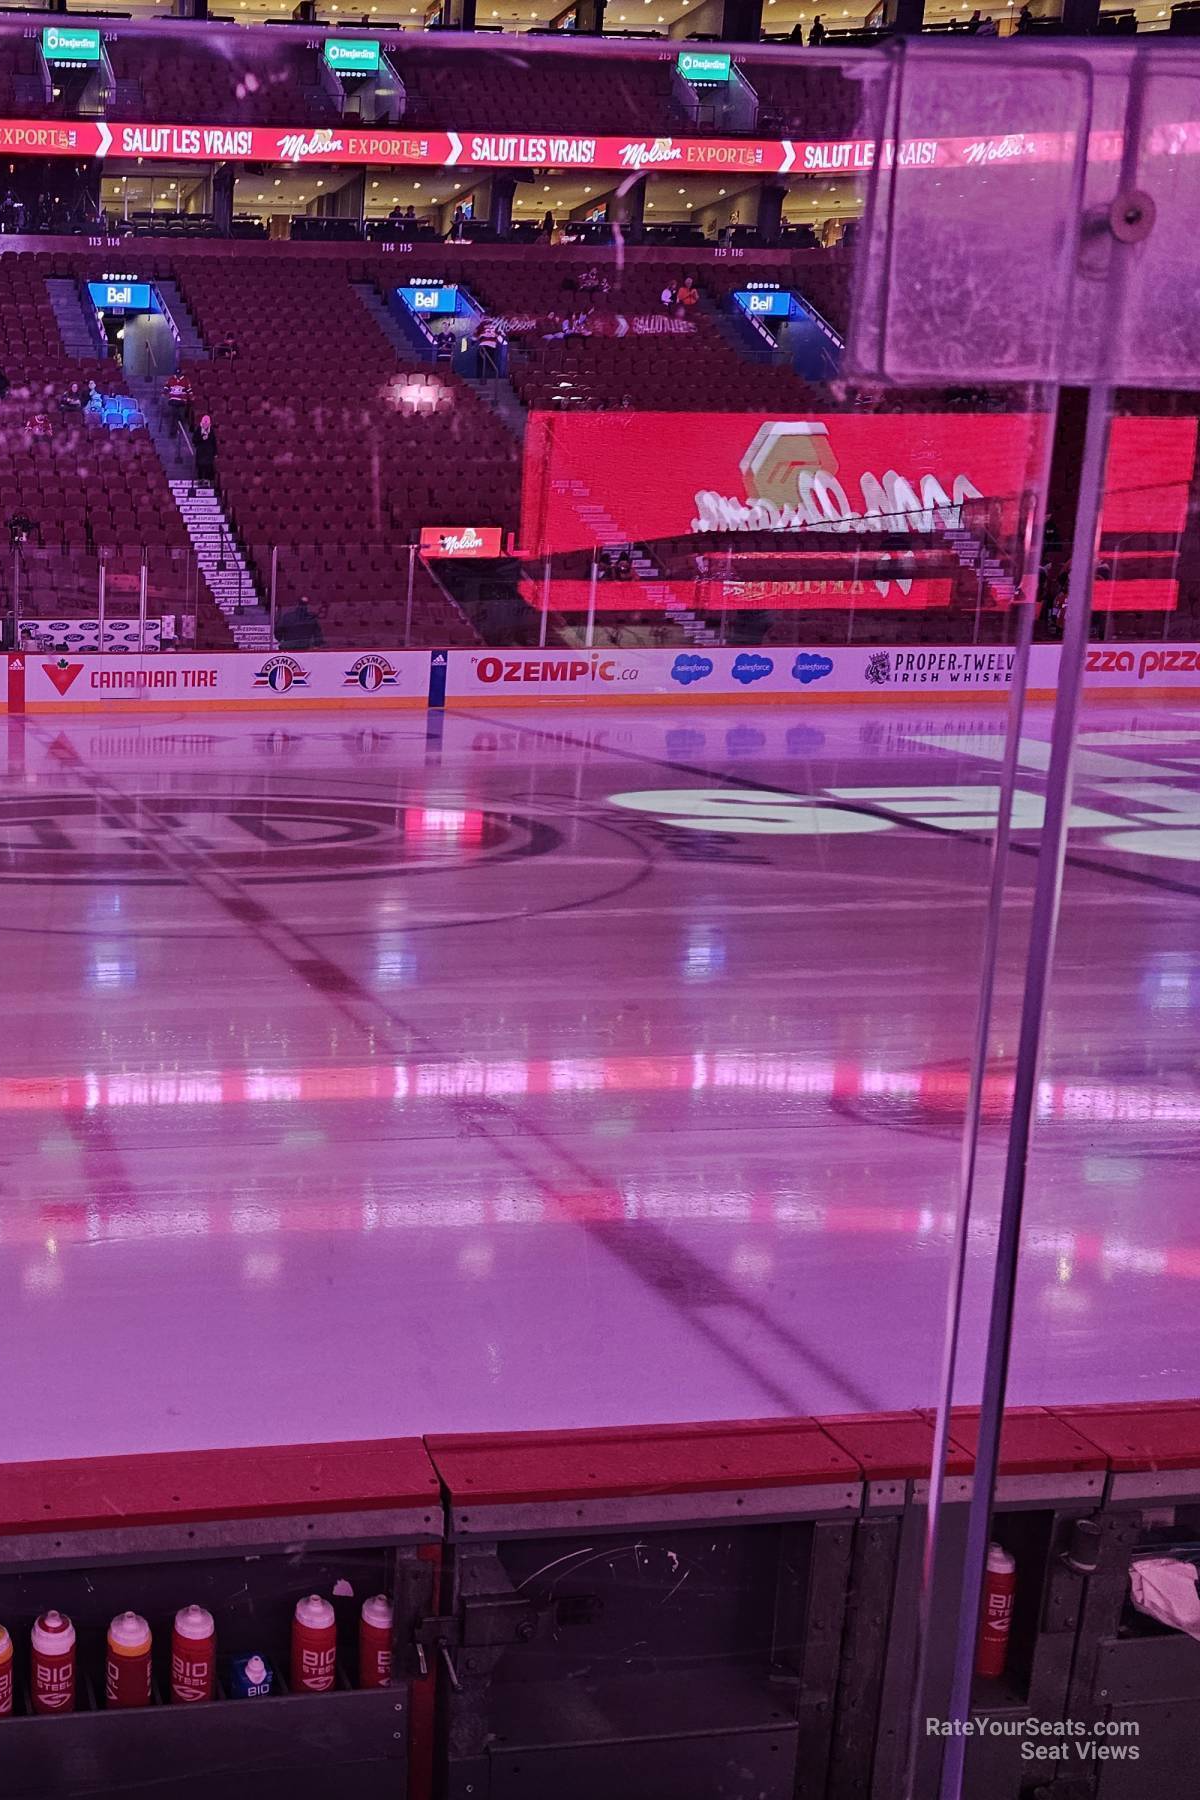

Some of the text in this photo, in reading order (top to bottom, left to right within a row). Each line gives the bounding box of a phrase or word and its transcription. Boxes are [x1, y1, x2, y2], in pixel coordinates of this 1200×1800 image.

[306, 40, 319, 49] 214
[383, 43, 396, 52] 215
[340, 48, 375, 59] Desjardins
[692, 60, 726, 70] Desjardins
[122, 127, 252, 155] SALUT LES VRAIS!
[276, 133, 343, 163] Molson
[348, 139, 409, 156] EXPORT
[471, 137, 596, 163] SALUT LES VRAIS!
[619, 141, 682, 170] Molson
[687, 147, 745, 164] EXPORT
[804, 144, 853, 169] SALUT
[855, 144, 874, 168] LE
[88, 238, 102, 246] 113
[107, 238, 120, 246] 114
[382, 243, 395, 251] 114
[400, 243, 413, 252] 115
[731, 249, 744, 257] 116
[107, 287, 131, 303] Bell
[415, 292, 438, 308] Bell
[750, 296, 773, 311] Bell
[438, 535, 482, 554] Molson
[265, 656, 297, 671] OLYMEL
[355, 655, 387, 671] OLYMEL
[677, 664, 709, 673] salesforce
[737, 664, 769, 673] salesforce
[798, 663, 830, 672] salesforce
[1085, 652, 1135, 671] zza
[91, 670, 217, 688] CANADIAN TIRE
[894, 673, 1013, 682] IRISH WHISKE
[303, 1647, 336, 1667] BIO
[37, 1664, 72, 1681] BIO
[172, 1654, 208, 1678] BIO
[37, 1680, 73, 1692] STEEL
[248, 1684, 270, 1697] BIO
